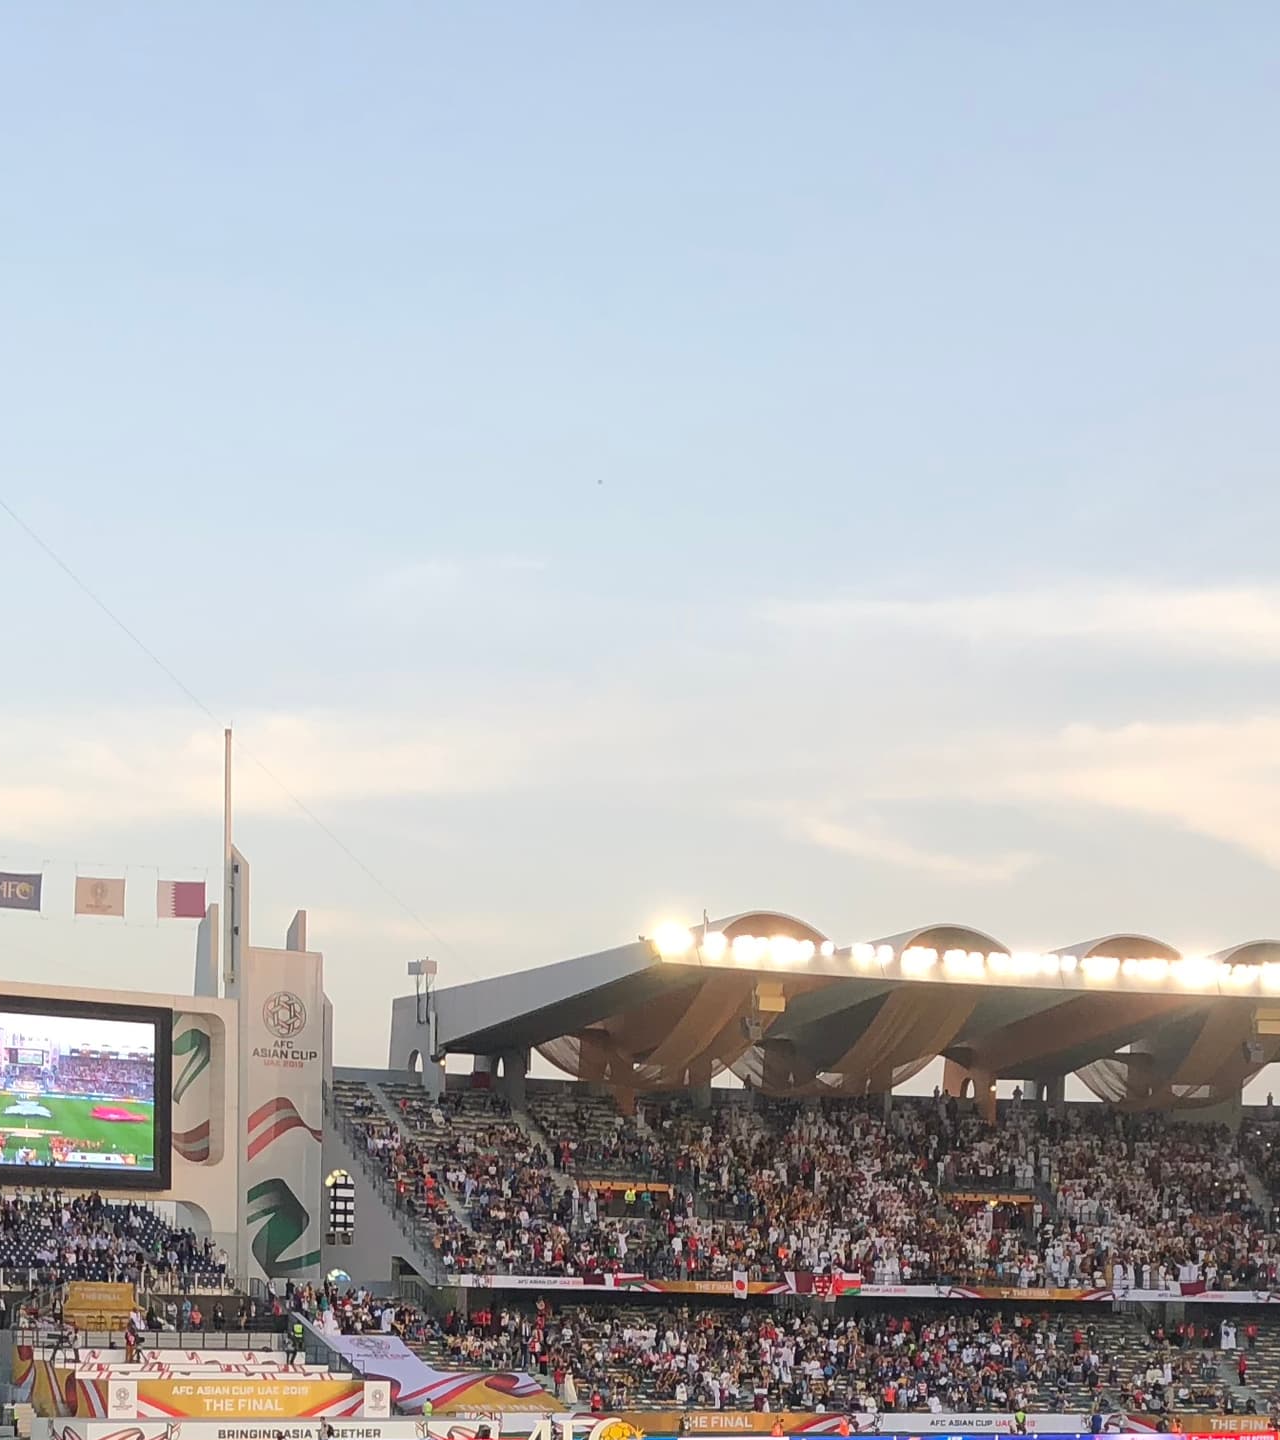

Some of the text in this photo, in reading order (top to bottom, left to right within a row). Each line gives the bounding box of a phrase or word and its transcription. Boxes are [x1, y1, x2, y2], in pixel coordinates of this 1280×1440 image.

[273, 1040, 294, 1049] AFC
[252, 1048, 318, 1061] ASIAN CUP
[172, 1386, 193, 1396] AFC
[197, 1386, 229, 1396] ASIAN
[232, 1386, 254, 1396] CUP
[203, 1399, 283, 1411] THE FINAL
[714, 1416, 753, 1428] FINAL
[930, 1419, 946, 1427] AFC
[948, 1419, 974, 1427] ASIAN
[1210, 1419, 1234, 1431] THE
[285, 1428, 313, 1439] ASIA
[315, 1428, 381, 1439] TGETHER
